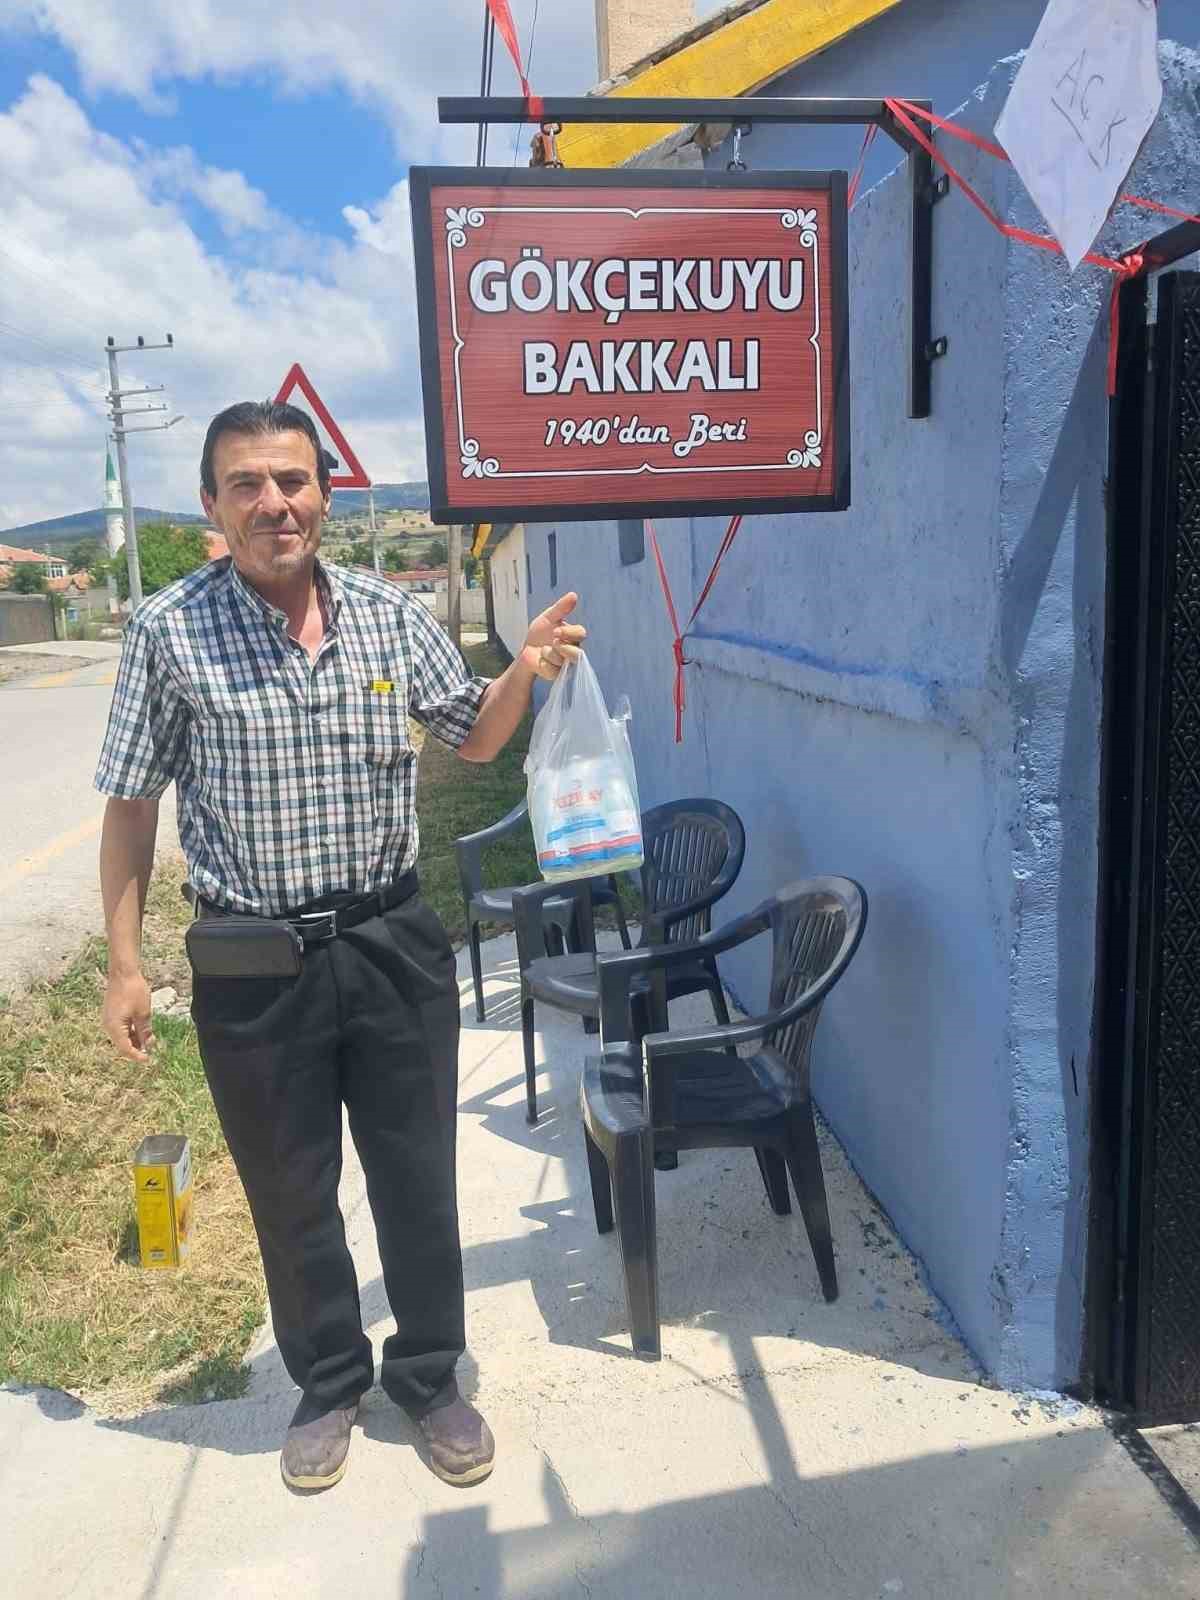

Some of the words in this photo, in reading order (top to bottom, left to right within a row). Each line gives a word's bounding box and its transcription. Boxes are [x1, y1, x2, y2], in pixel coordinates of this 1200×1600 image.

[470, 247, 804, 324] GÖKÇEKUYU
[523, 339, 760, 394] BAKKALI
[544, 415, 670, 447] 1940'dan
[673, 413, 747, 457] Beri
